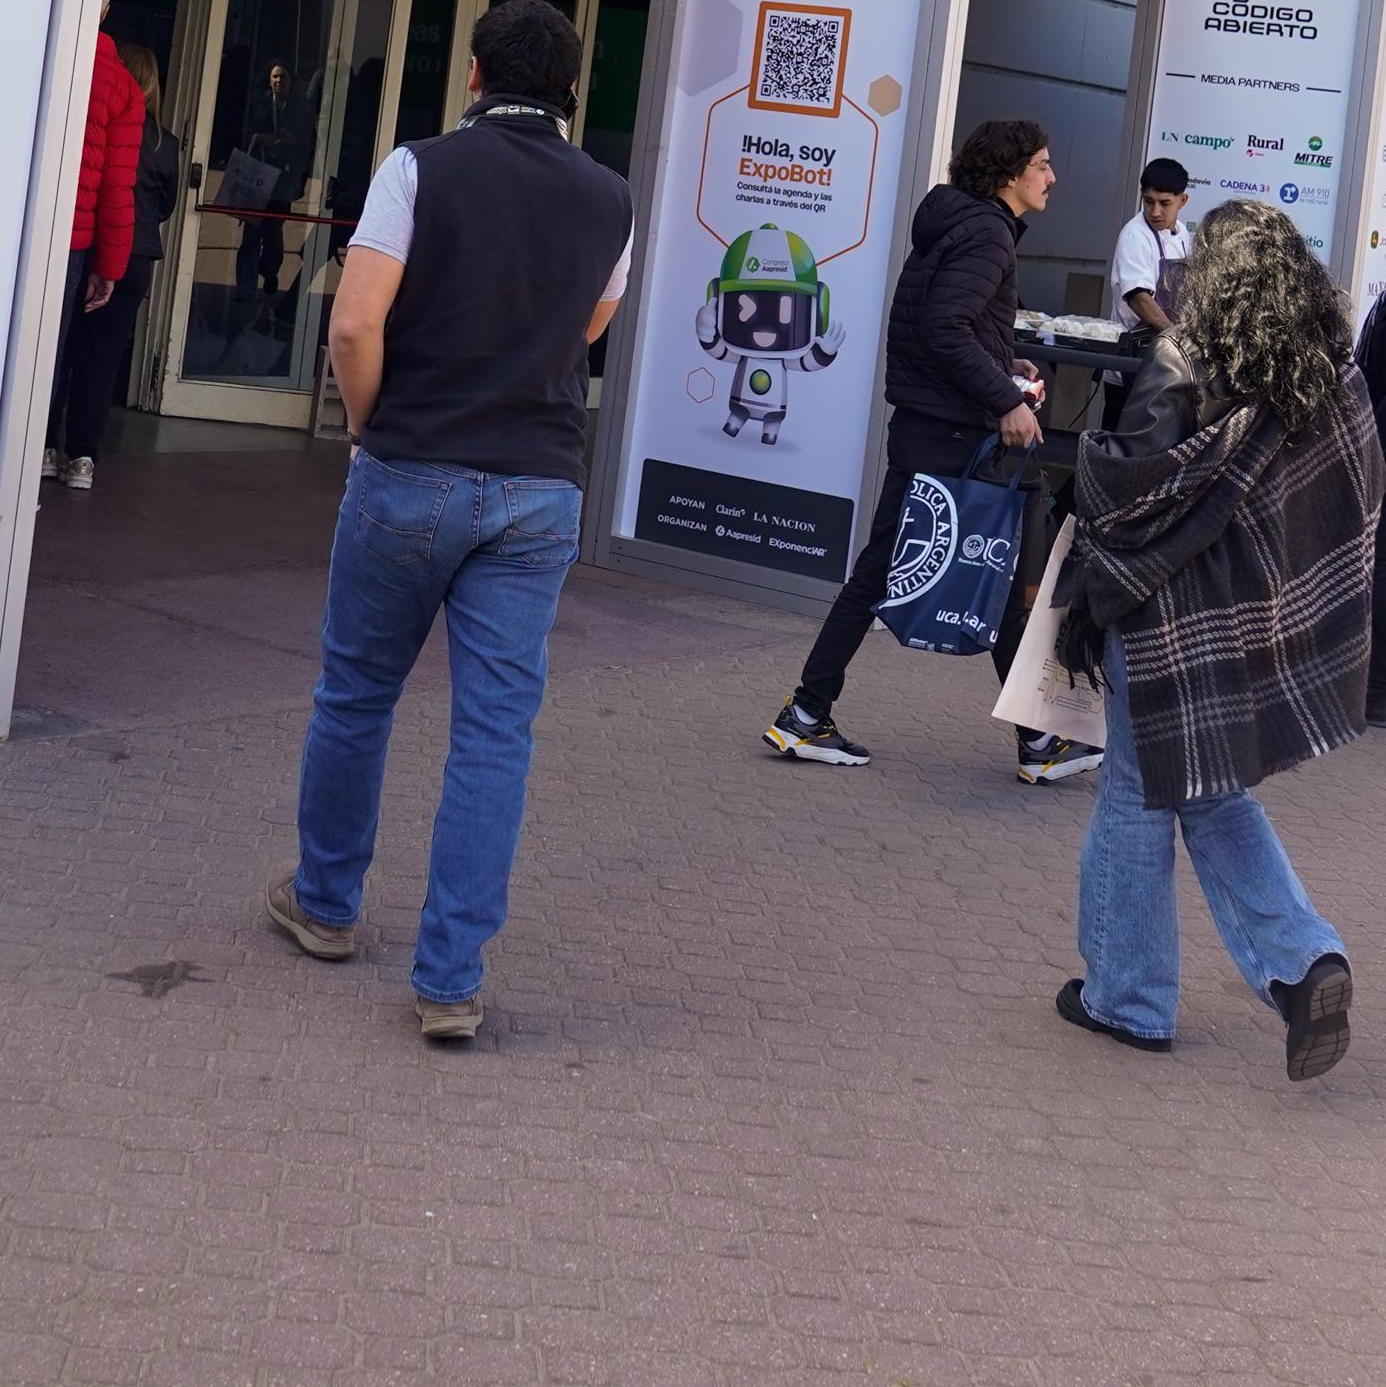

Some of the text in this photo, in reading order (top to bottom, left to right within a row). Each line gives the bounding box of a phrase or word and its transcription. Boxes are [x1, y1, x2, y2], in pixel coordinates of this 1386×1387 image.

[1204, 18, 1318, 40] ABIERTO
[1200, 73, 1300, 93] MEDIA PARTNERS
[1162, 132, 1231, 150] LN campo
[1247, 134, 1284, 151] Rural
[798, 145, 836, 167] soy
[1295, 152, 1333, 165] MITRE
[739, 157, 832, 187] ExpoBot!
[737, 181, 773, 194] Consultá
[774, 185, 781, 195] la
[782, 187, 812, 199] agenda
[820, 192, 832, 202] las
[1220, 179, 1266, 193] CADENA 3
[1301, 186, 1330, 198] AM 910
[735, 193, 764, 205] charlas
[772, 198, 798, 209] través
[799, 201, 813, 212] del
[813, 203, 826, 213] QR
[669, 495, 706, 510] APOYAN
[657, 514, 707, 532] ORGANIZAN
[753, 512, 816, 533] LA NACION
[726, 529, 762, 544] Aapresid
[887, 521, 951, 599] ARGENTIN
